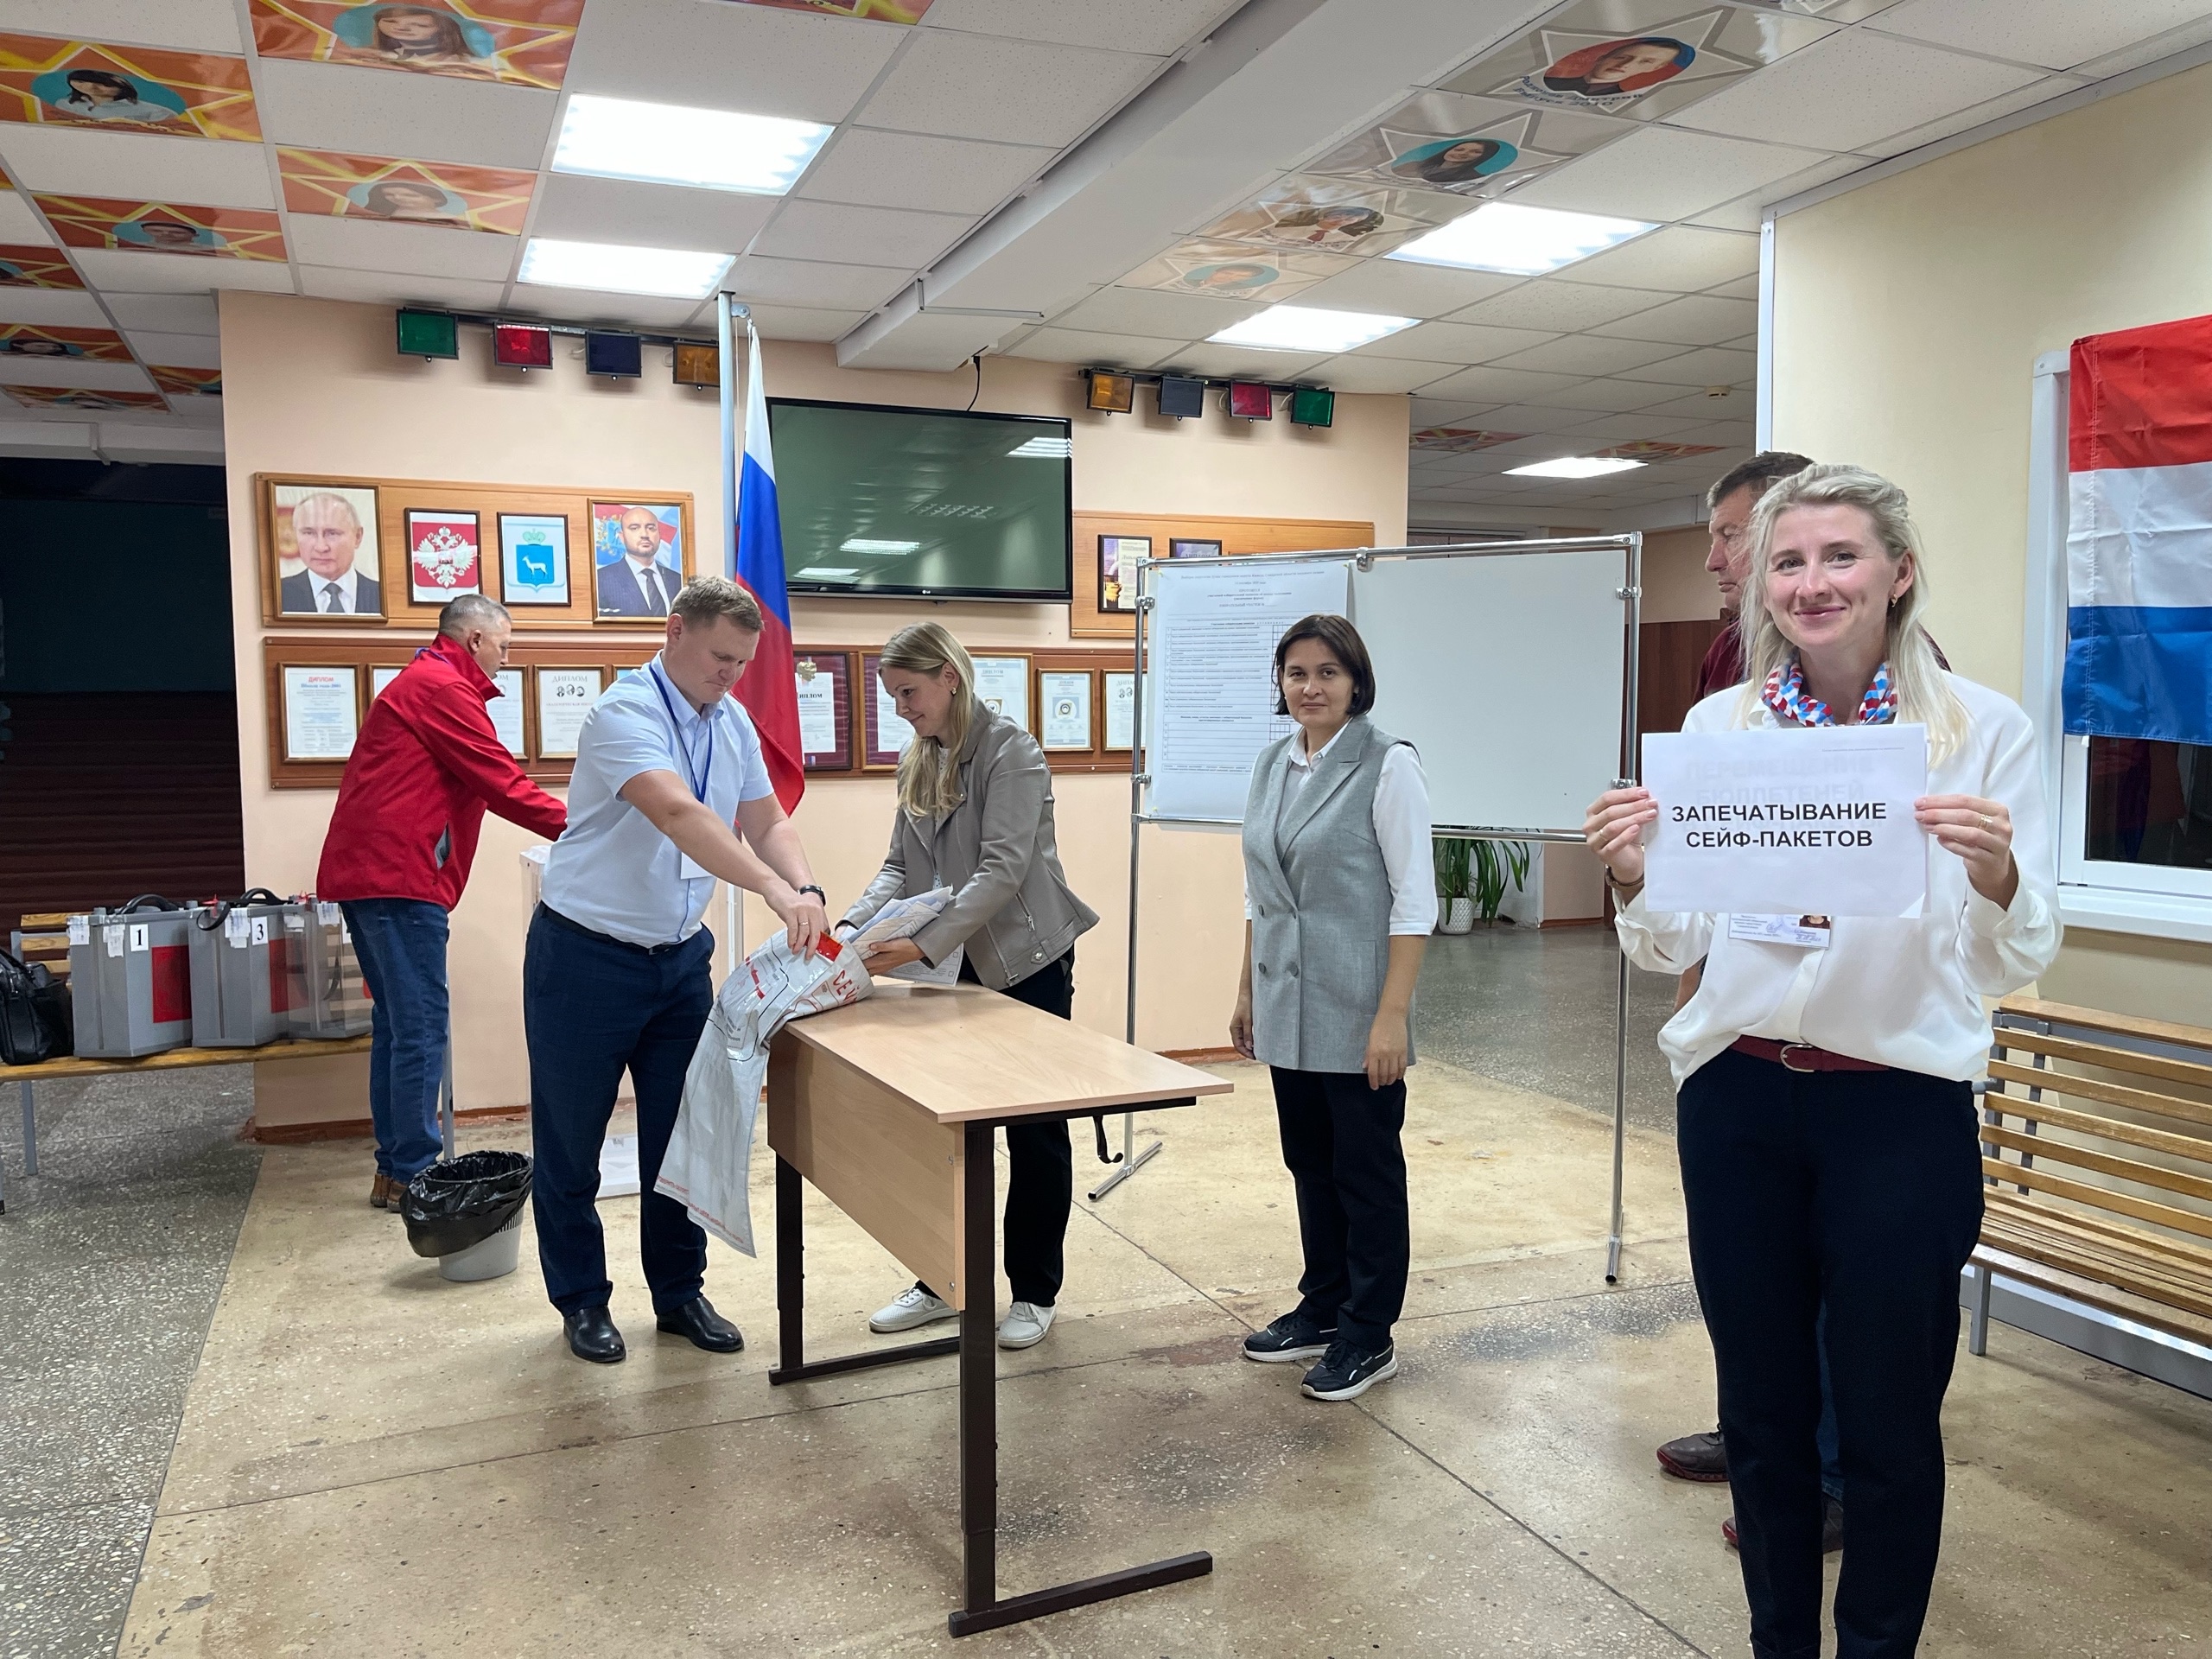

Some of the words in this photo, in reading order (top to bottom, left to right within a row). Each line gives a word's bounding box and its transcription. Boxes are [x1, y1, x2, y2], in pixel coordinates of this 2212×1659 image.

[551, 675, 588, 683] ДИПЛОМ
[1672, 803, 1887, 823] ЗАПЕЧАТЫВАНИЕ
[1686, 827, 1872, 848] СЕЙФ-ПАКЕТОВ
[136, 928, 143, 947] 1
[257, 923, 264, 941] 3
[832, 969, 861, 1003] СЕЙ
